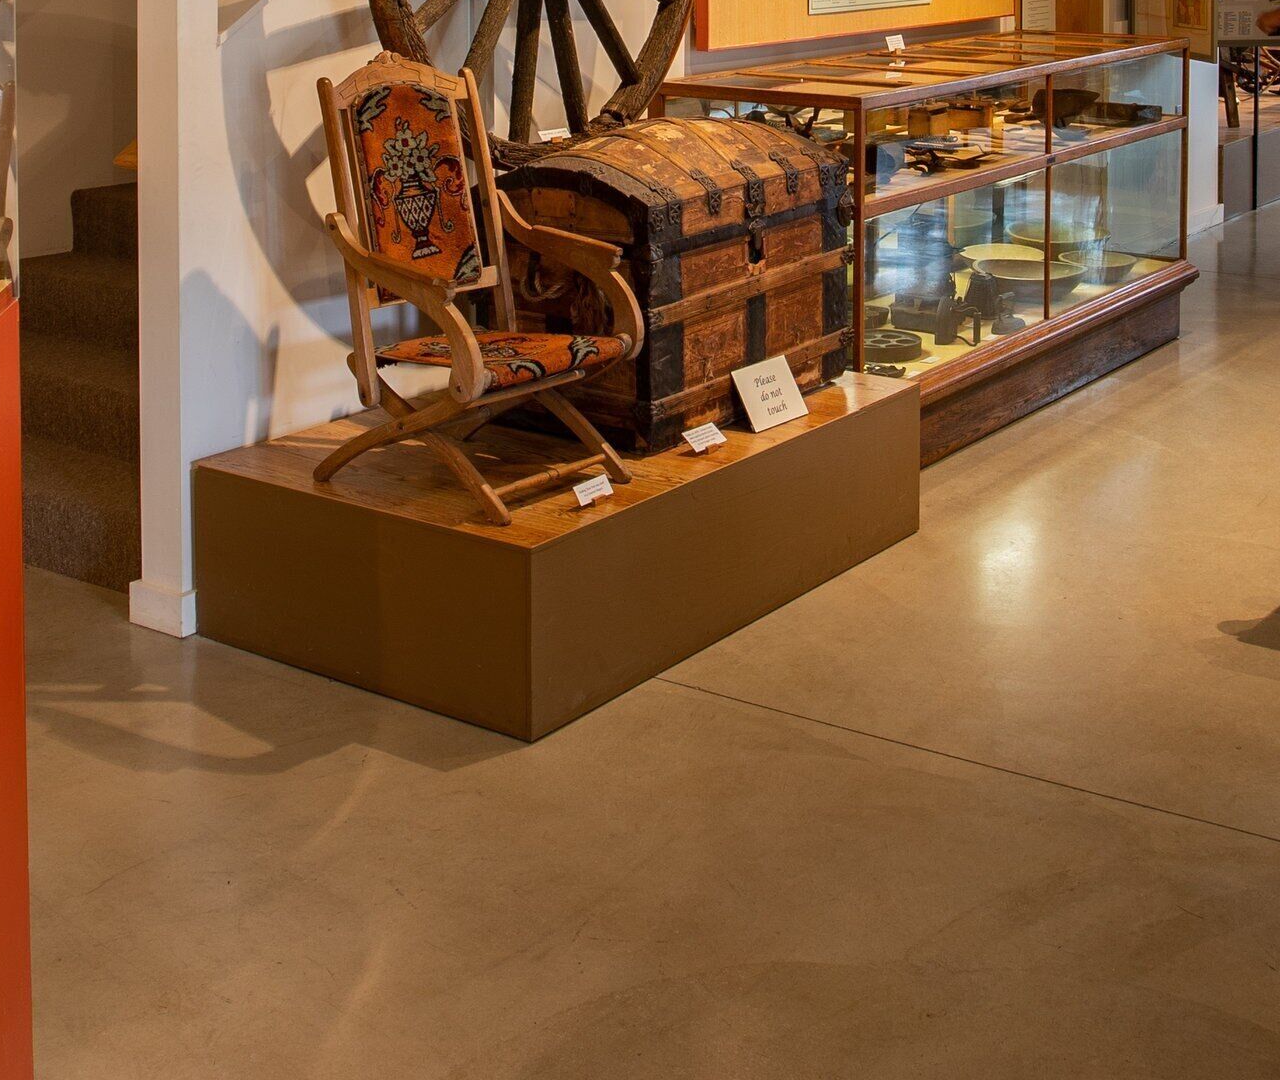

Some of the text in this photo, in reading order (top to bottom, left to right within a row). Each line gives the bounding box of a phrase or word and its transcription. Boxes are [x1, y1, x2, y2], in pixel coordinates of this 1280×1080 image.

[754, 374, 776, 387] Please
[760, 387, 782, 401] do not
[767, 400, 787, 415] touch
